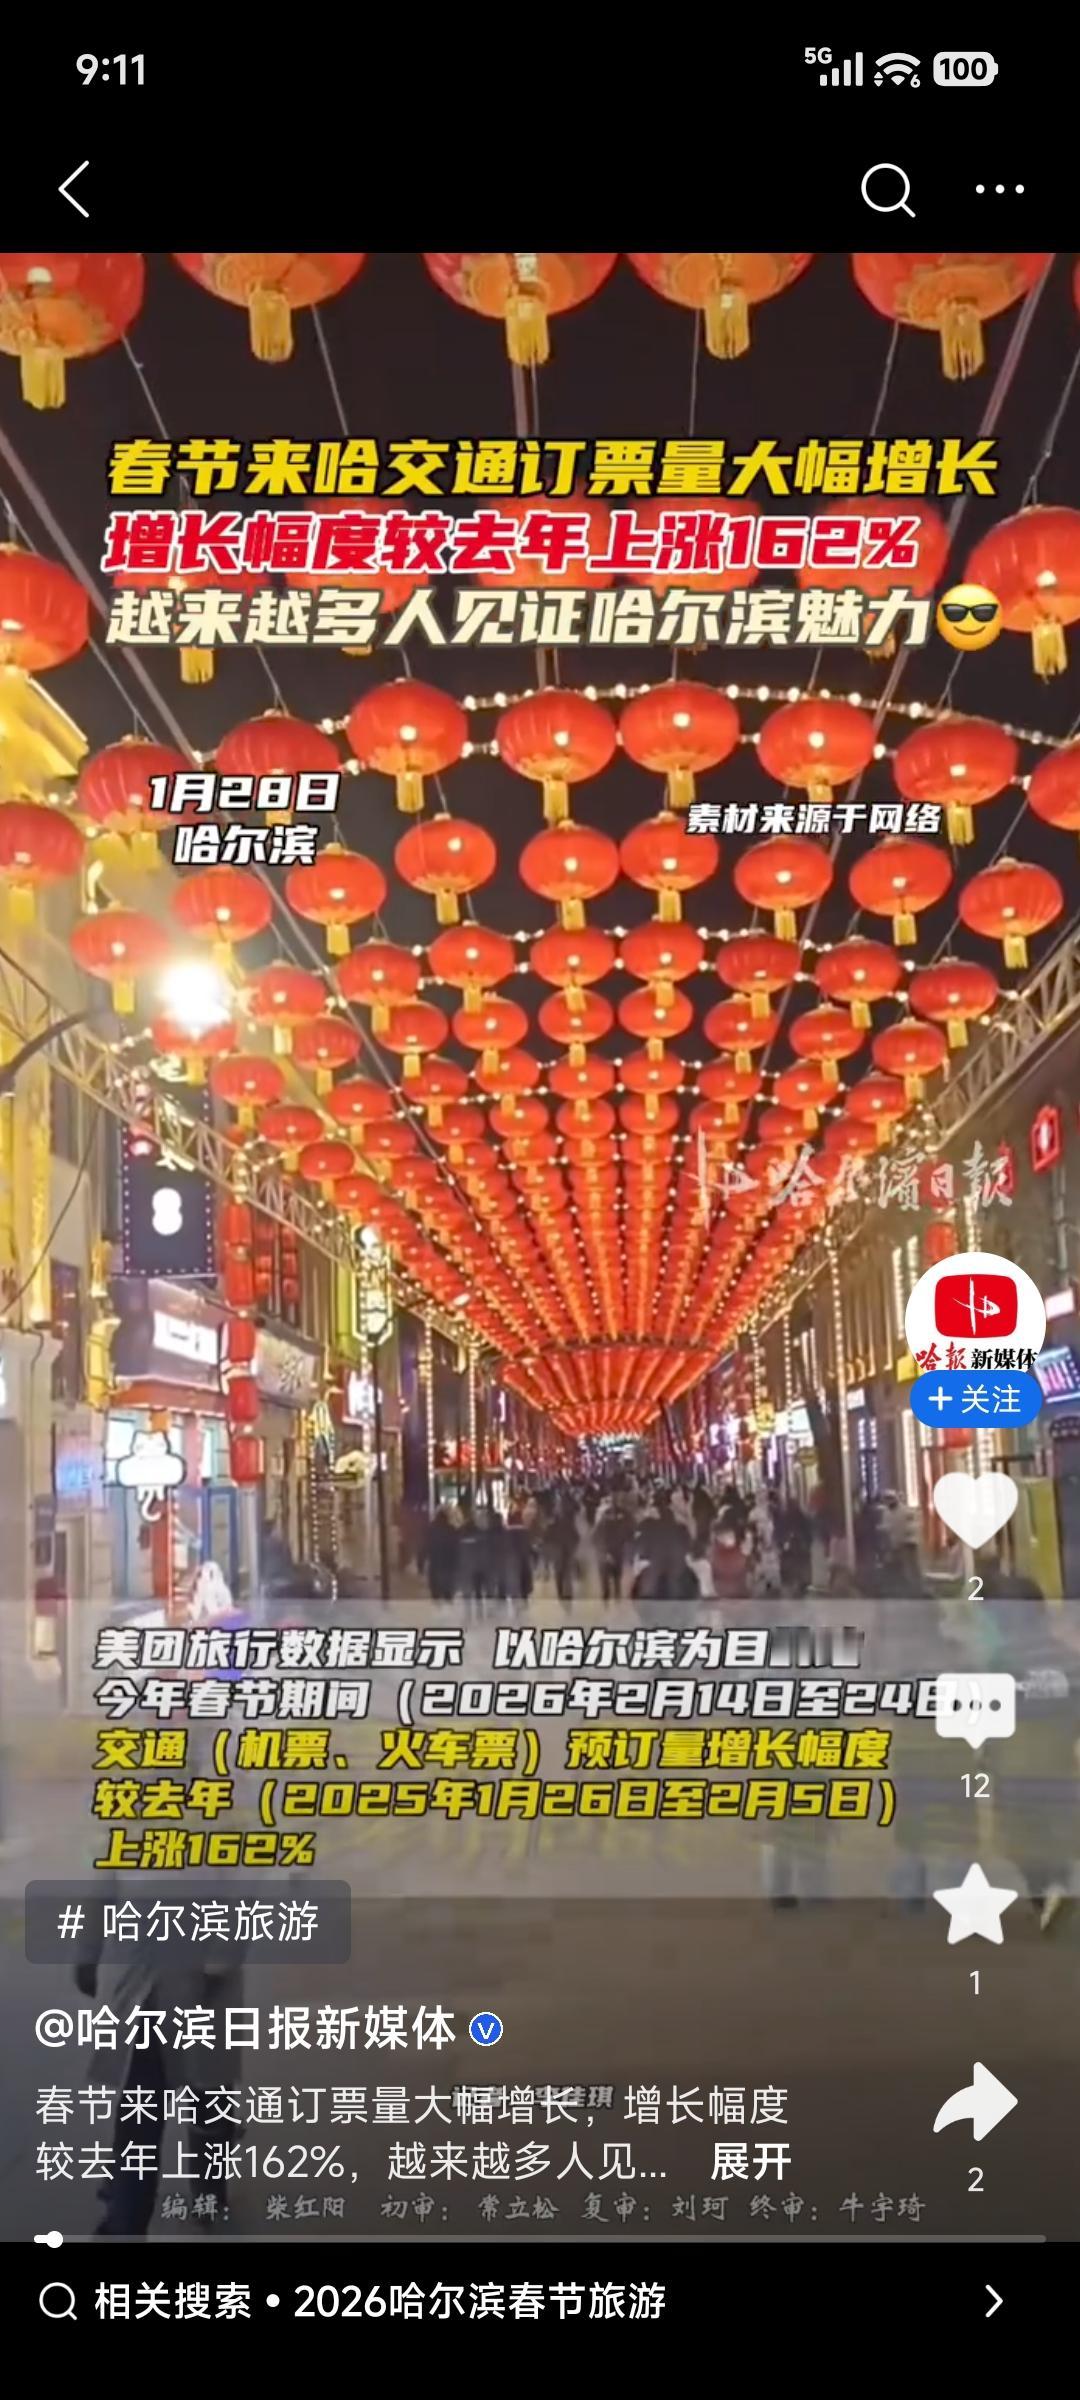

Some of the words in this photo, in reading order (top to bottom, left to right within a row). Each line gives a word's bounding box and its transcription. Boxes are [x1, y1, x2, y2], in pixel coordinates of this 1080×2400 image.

[76, 53, 145, 86] 9:11
[804, 46, 833, 65] 5G
[939, 57, 988, 81] 100
[94, 2281, 252, 2320] 相关搜索
[293, 2281, 667, 2320] 2026哈尔滨春节旅游
